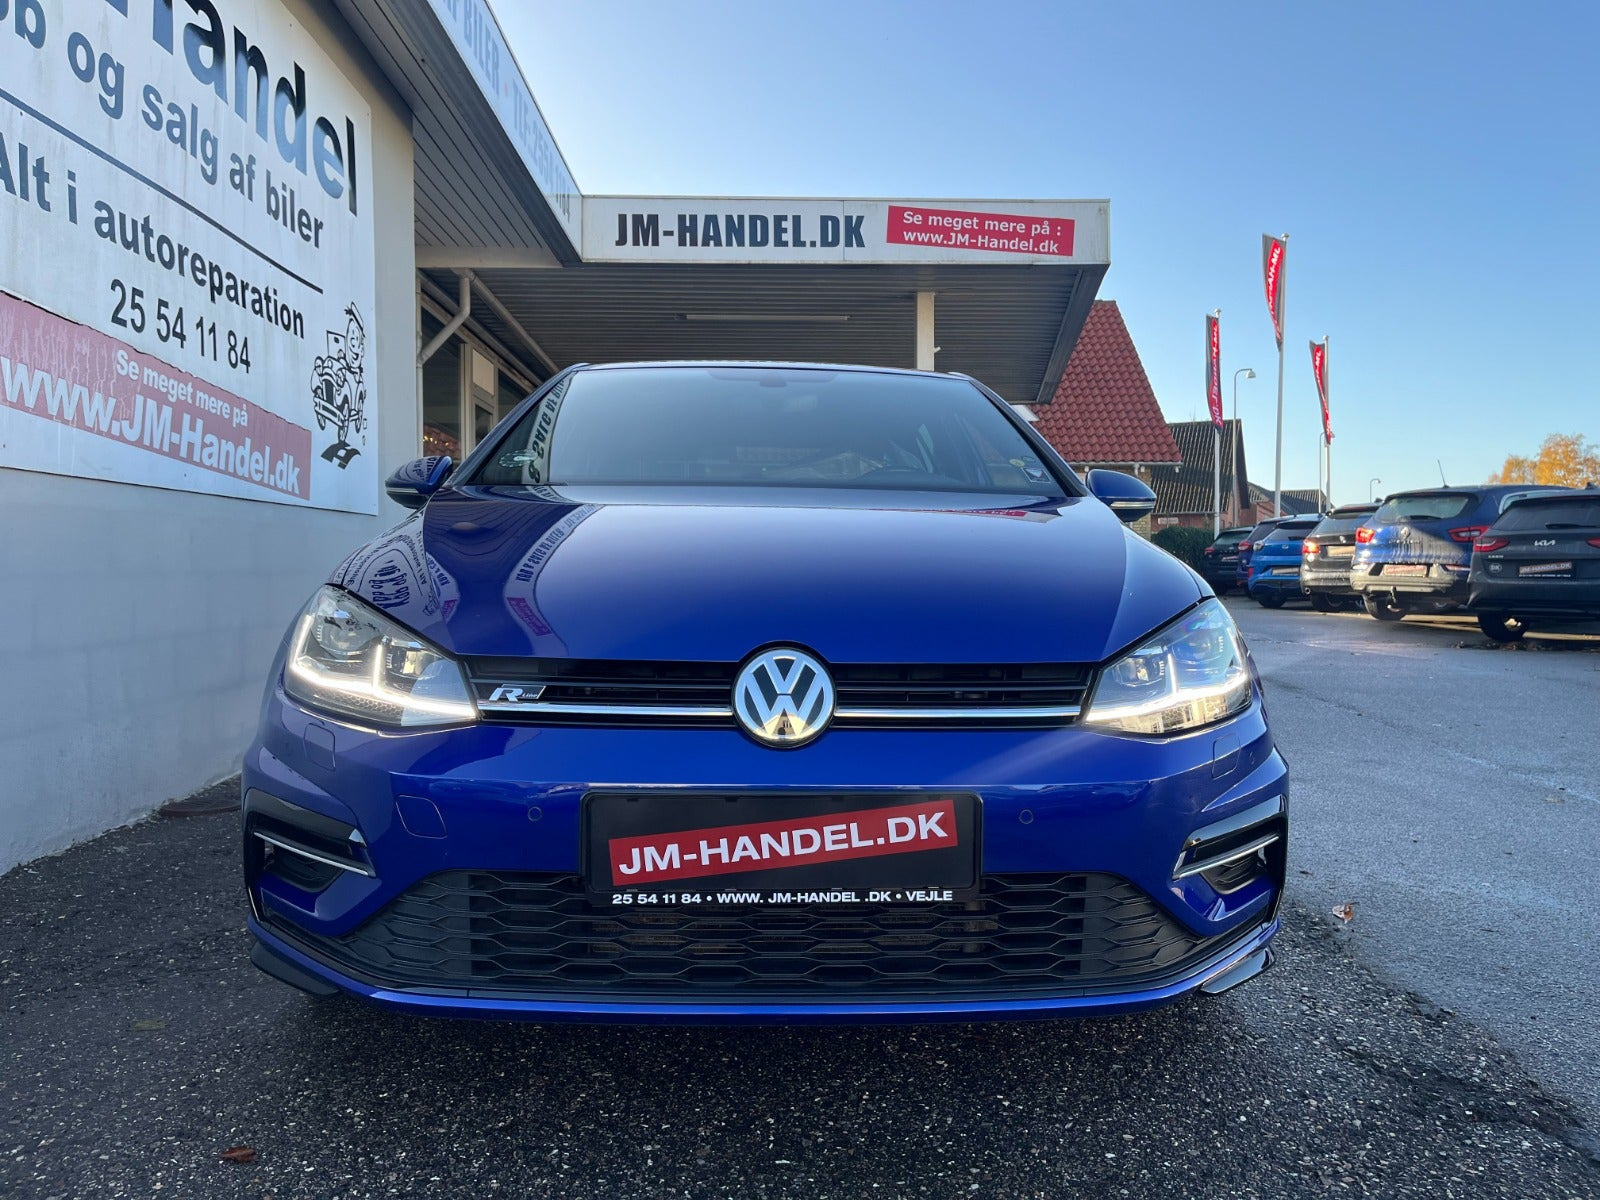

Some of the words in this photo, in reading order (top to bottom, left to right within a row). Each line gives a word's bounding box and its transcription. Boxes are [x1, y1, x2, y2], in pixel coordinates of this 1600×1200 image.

[67, 31, 125, 120] og
[141, 84, 218, 186] salg
[229, 152, 256, 202] af
[265, 168, 324, 249] biler
[67, 169, 78, 225] i
[94, 200, 305, 339] autoreparation
[614, 213, 866, 248] JM-HANDEL.DK
[902, 211, 922, 225] Se
[927, 213, 979, 231] meget
[984, 219, 1026, 233] mere
[1030, 220, 1050, 237] på
[902, 230, 1059, 253] www.JM-Handel.dk
[110, 278, 146, 334] 25
[156, 297, 187, 350] 54
[196, 316, 218, 362] 11
[227, 332, 251, 374] 84
[116, 349, 139, 381] Se
[143, 367, 193, 404] meget
[196, 388, 231, 420] mere
[232, 403, 249, 428] på
[0, 355, 300, 495] www.JM-Handel.dk
[488, 687, 524, 702] R
[618, 811, 949, 876] JM-HANDEL.DK
[612, 893, 634, 905] 25
[636, 893, 658, 904] 54
[661, 893, 677, 904] 11
[680, 892, 702, 904] 84
[716, 892, 764, 904] WWW.
[767, 891, 860, 904] JM-HANDEL
[863, 891, 892, 903] .DK
[905, 890, 953, 903] VEJLE
